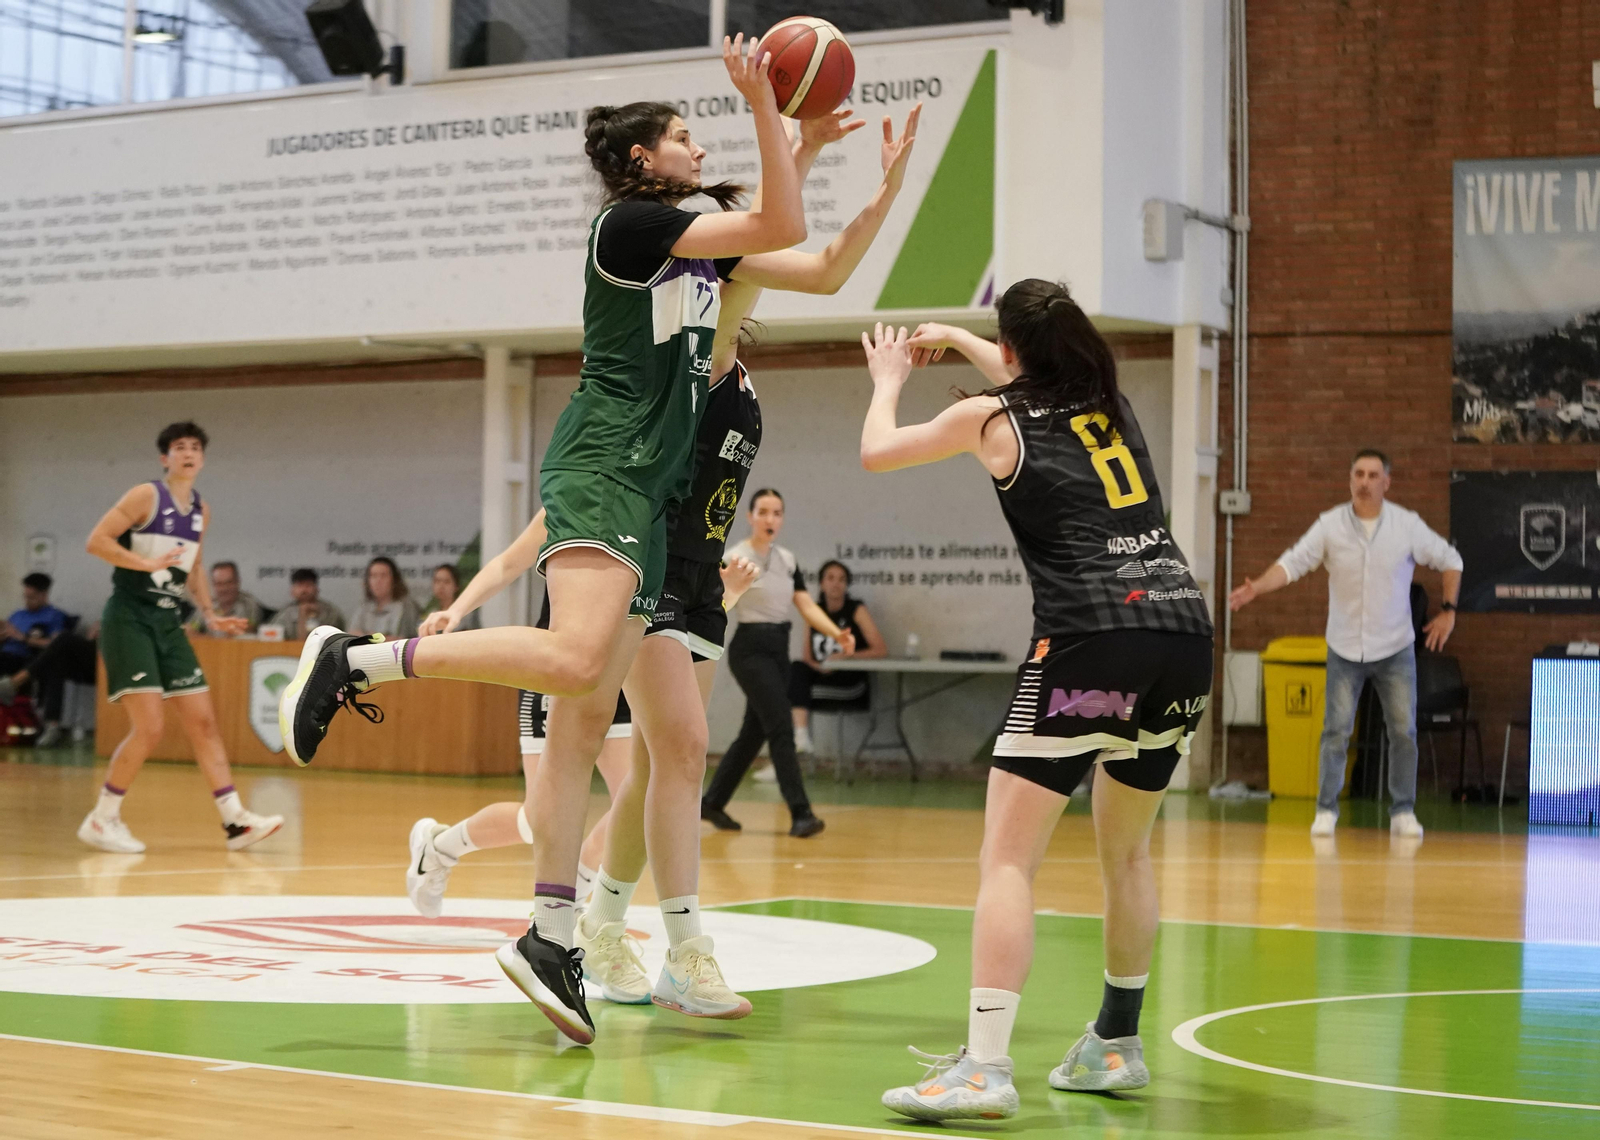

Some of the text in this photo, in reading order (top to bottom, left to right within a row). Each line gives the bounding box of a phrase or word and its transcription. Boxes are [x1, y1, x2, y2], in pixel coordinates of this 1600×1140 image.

[695, 95, 737, 118] CON
[861, 77, 942, 106] EQUIPO
[266, 128, 369, 157] JUGADORES
[373, 126, 398, 147] DE
[401, 119, 486, 145] CANTERA
[490, 113, 532, 138] QUE
[535, 109, 578, 133] HAN
[1465, 170, 1562, 237] ¡VIVE
[1069, 411, 1149, 510] 8
[835, 543, 854, 560] La
[857, 541, 915, 560] derrota
[919, 543, 934, 560] te
[939, 541, 1008, 560] alimenta
[847, 569, 895, 585] errota
[898, 572, 916, 586] se
[920, 569, 983, 588] aprende
[988, 568, 1022, 586] más
[126, 950, 302, 972] DEL
[312, 967, 505, 990] SOL
